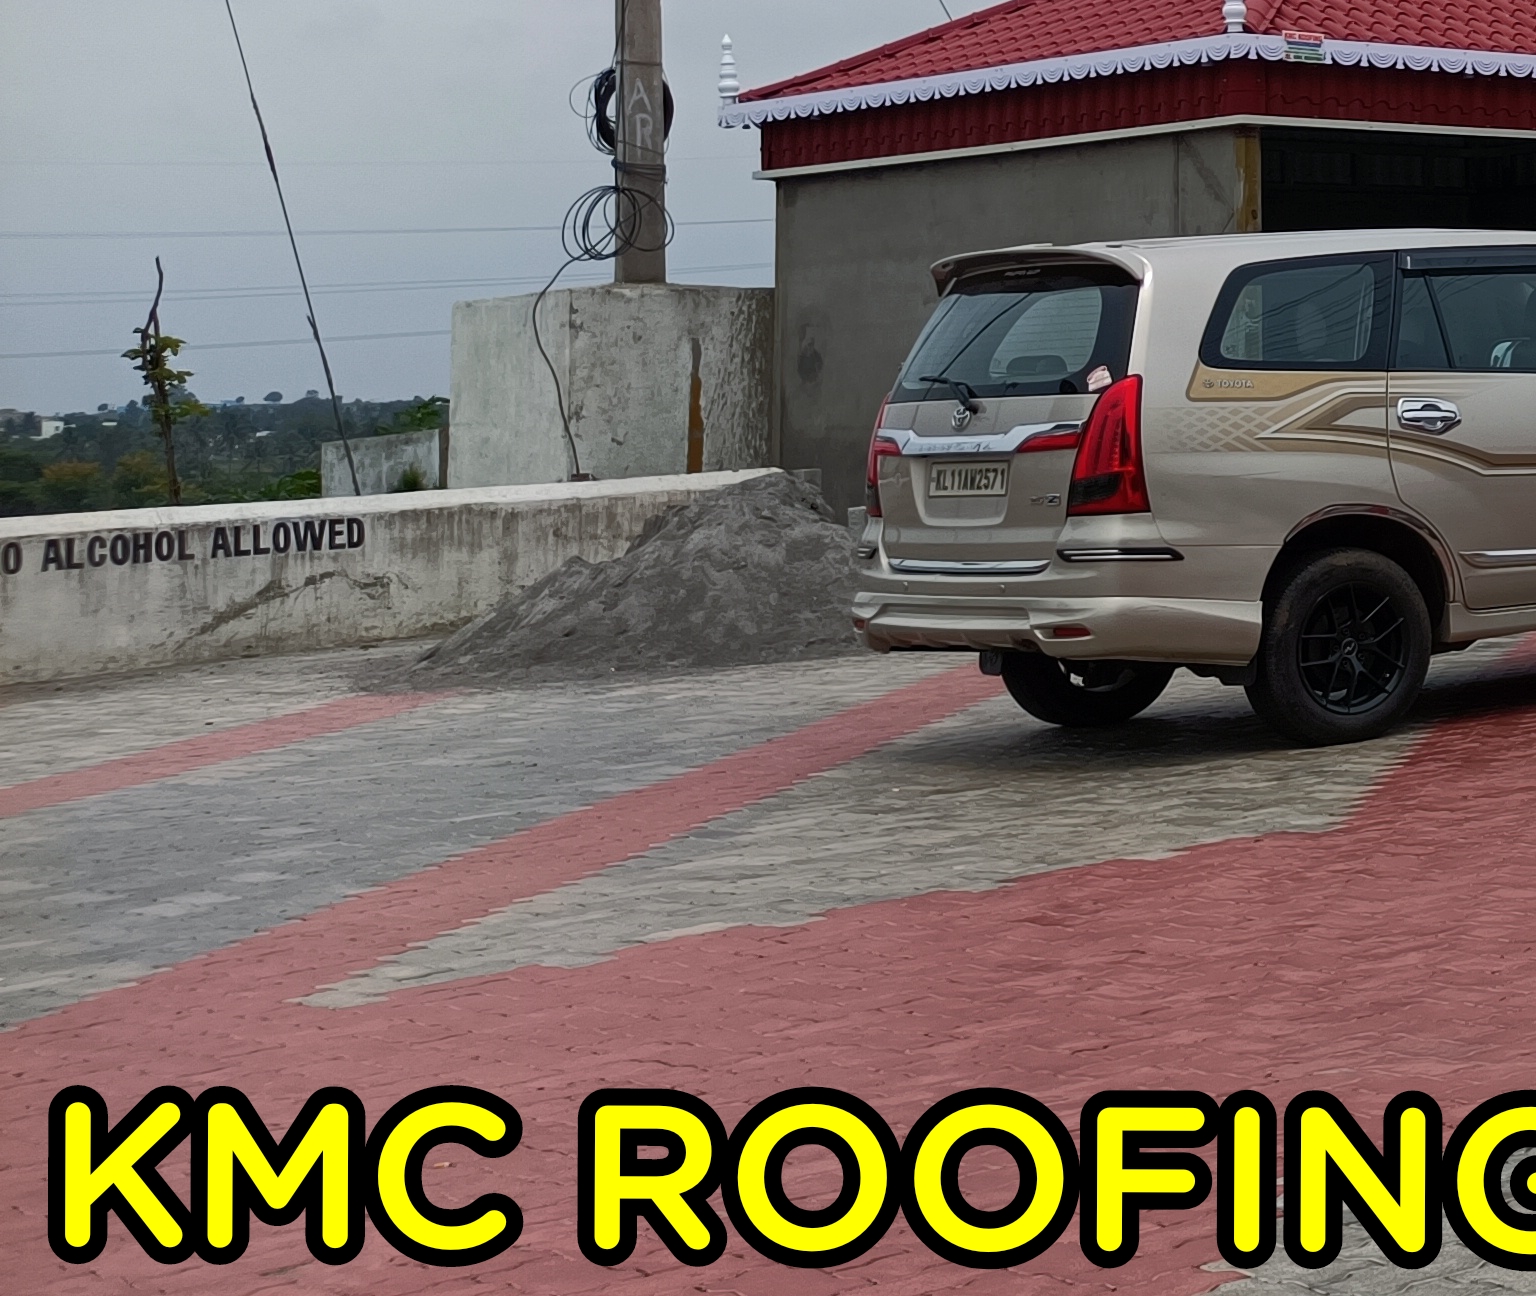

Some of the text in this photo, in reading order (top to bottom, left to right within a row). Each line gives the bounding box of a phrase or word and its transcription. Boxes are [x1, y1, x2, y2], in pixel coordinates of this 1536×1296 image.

[1216, 379, 1255, 389] TOYOTA
[40, 529, 196, 573] ALCOHOL
[210, 517, 366, 560] ALLOWED
